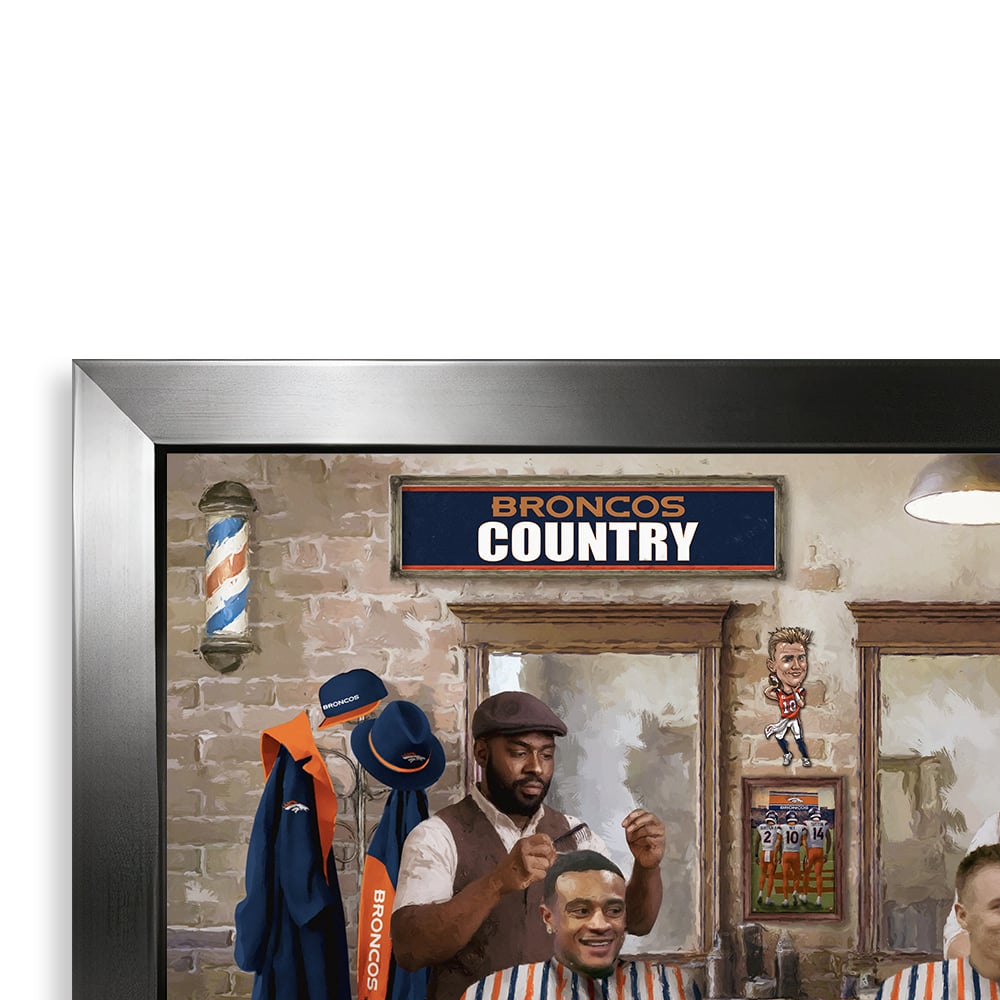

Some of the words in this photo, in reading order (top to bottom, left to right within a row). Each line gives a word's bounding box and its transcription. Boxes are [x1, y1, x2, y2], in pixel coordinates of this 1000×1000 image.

[491, 495, 686, 518] BRONCOS
[477, 521, 699, 562] COUNTRY
[322, 694, 360, 711] BRONCOS
[782, 699, 796, 714] 10
[763, 831, 772, 843] 2
[786, 831, 799, 844] 10
[812, 827, 824, 840] 14
[367, 889, 386, 991] BRONCOS
